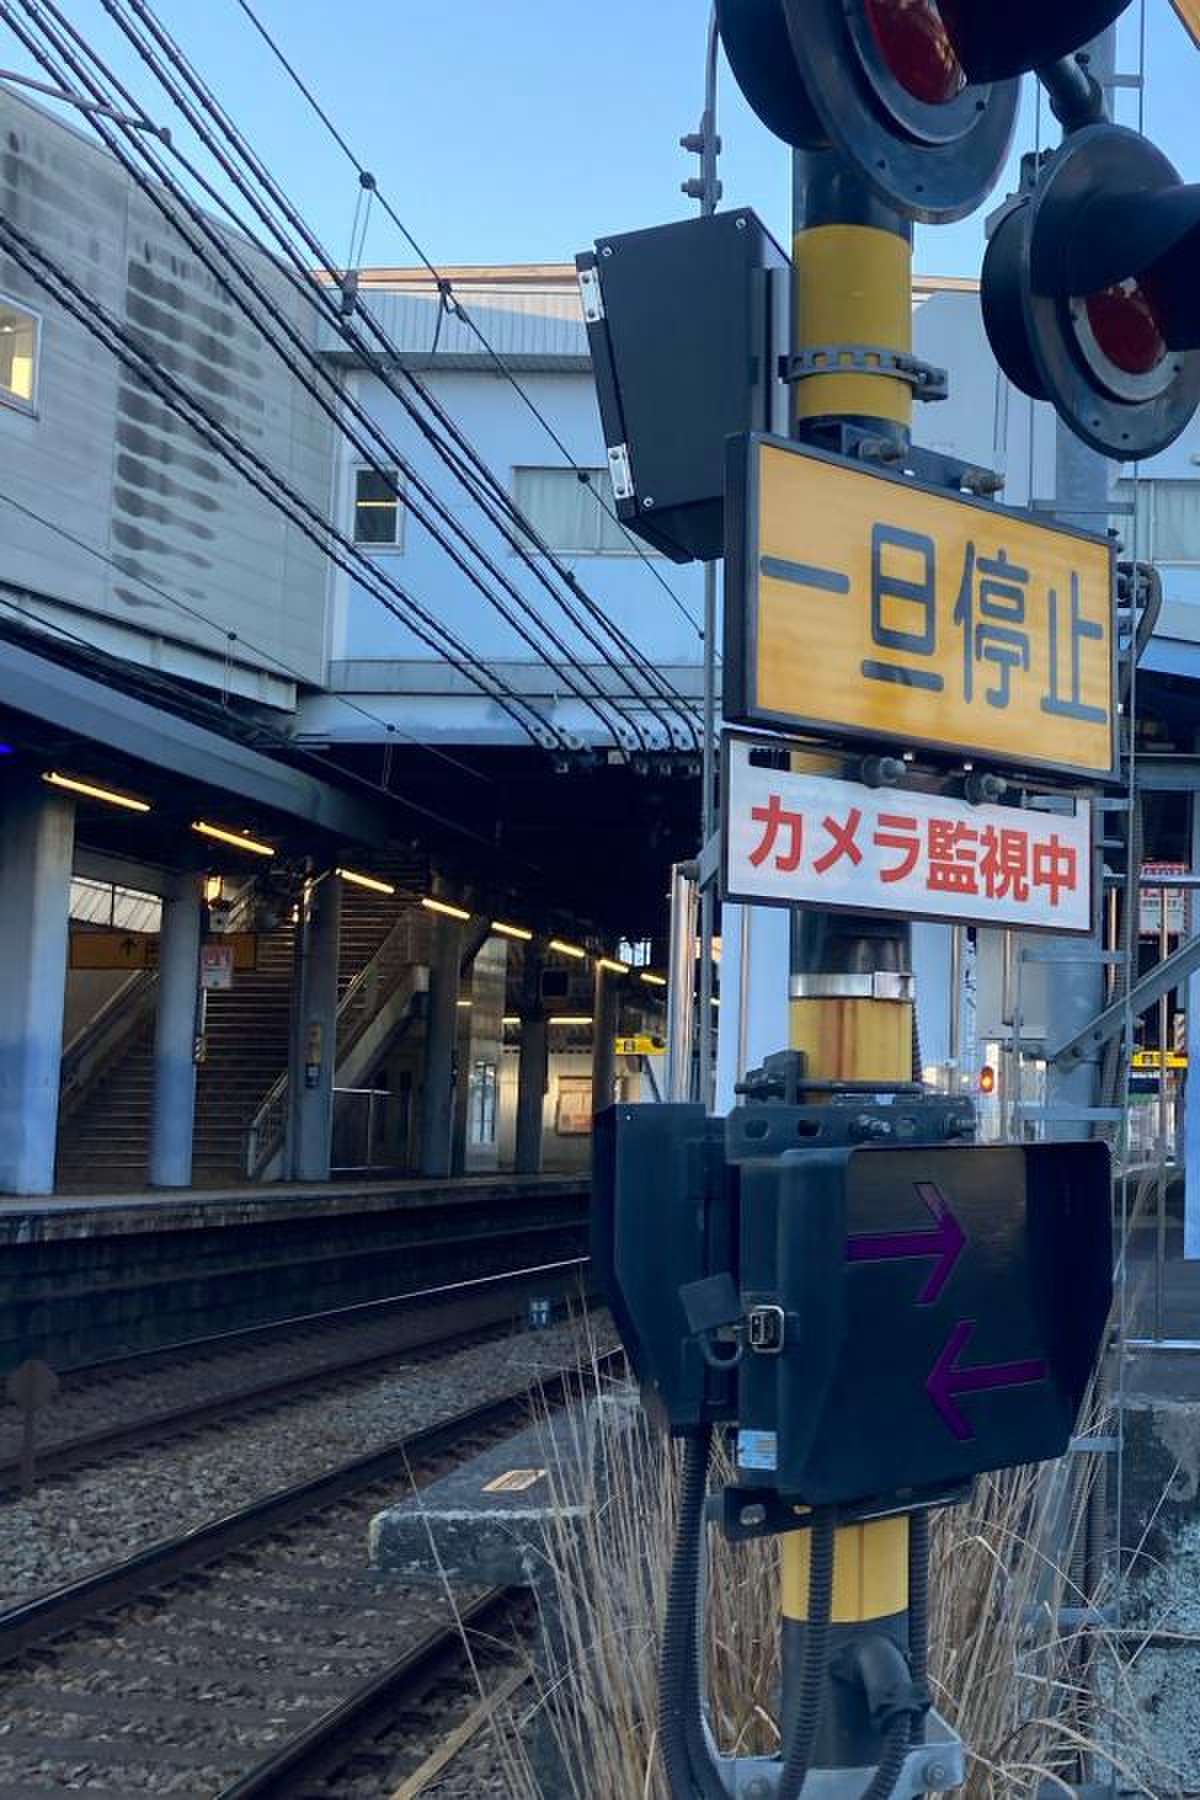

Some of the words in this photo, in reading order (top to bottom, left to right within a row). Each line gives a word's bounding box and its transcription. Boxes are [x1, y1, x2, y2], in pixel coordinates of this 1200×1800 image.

[761, 522, 1108, 724] 一旦停止
[748, 795, 1076, 906] カメラ監視中
